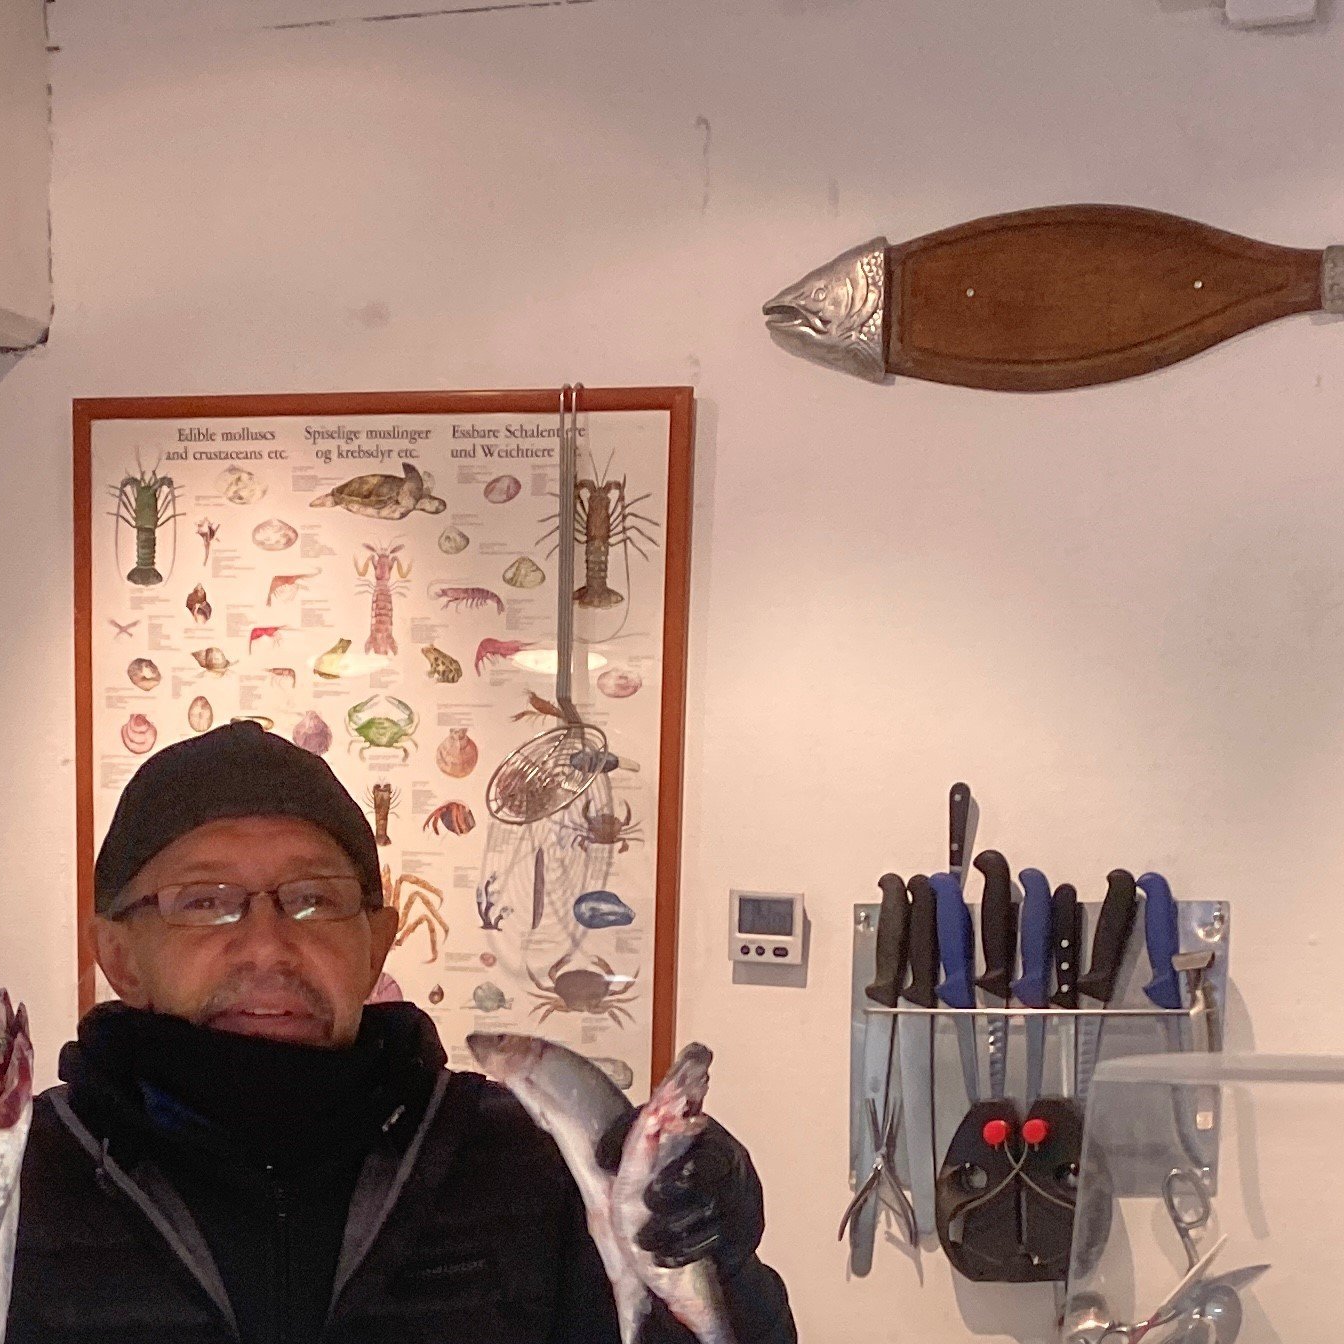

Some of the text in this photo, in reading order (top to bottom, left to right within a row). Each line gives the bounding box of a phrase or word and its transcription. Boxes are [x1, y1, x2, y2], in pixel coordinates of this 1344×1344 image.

[177, 427, 276, 442] Edible molluscs
[304, 425, 432, 445] Spiselige muslinger
[451, 424, 500, 439] Essbare
[165, 446, 289, 460] and crustaceans etc.
[315, 444, 420, 464] og krebsdyr etc.
[450, 443, 476, 458] und
[480, 443, 555, 458] Weichtiere
